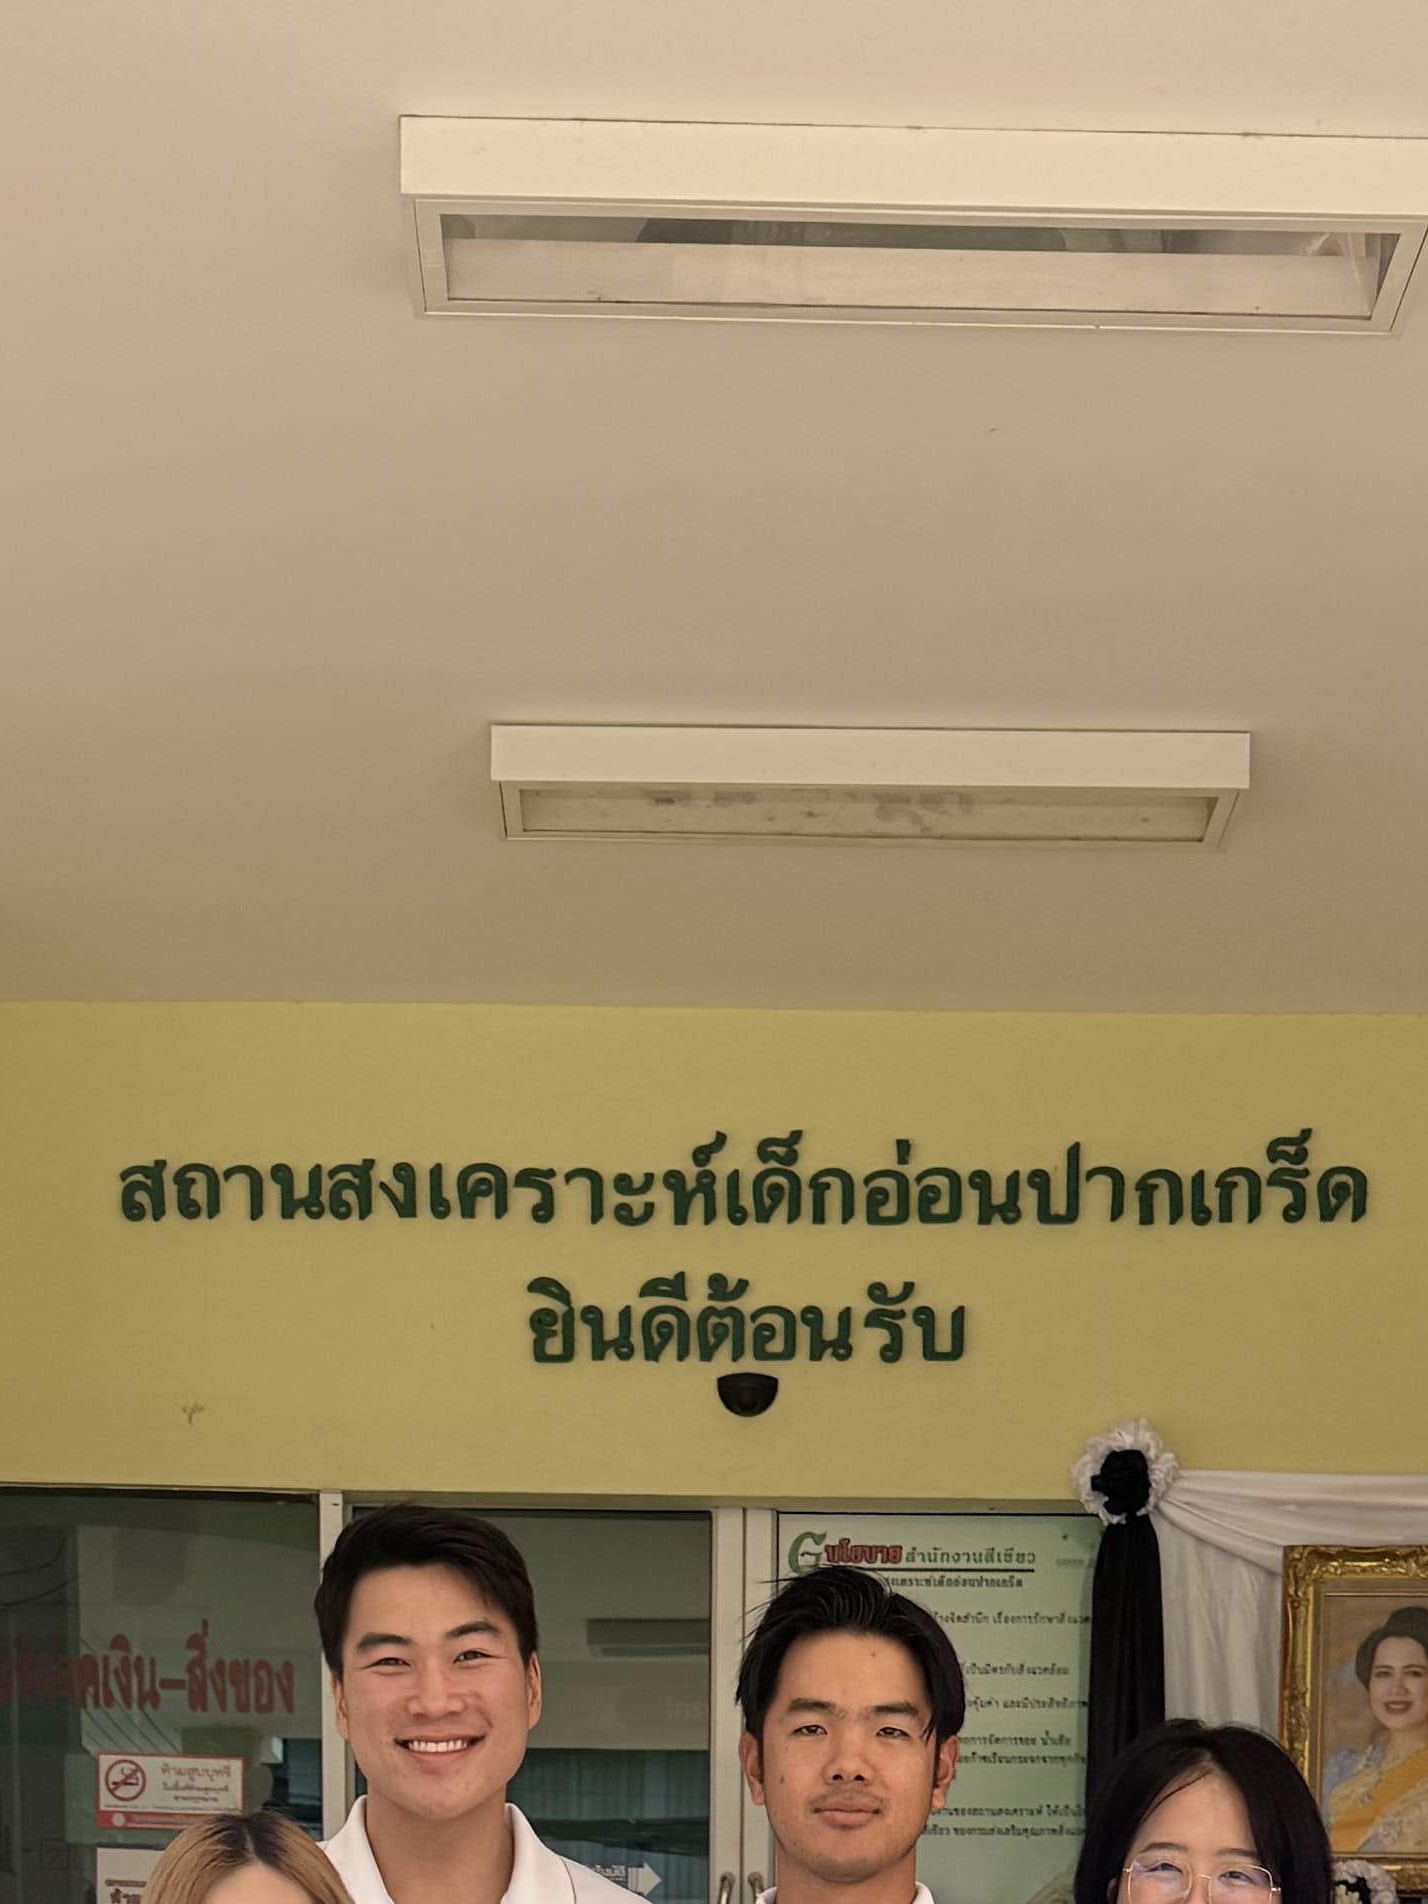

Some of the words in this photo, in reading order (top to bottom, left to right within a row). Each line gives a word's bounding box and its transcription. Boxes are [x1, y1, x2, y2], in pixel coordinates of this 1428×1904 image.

[118, 1131, 1370, 1227] สถานสงเคราะห์เด็กอ่อนปากเกร็ด
[527, 1271, 968, 1365] ยินดีต้อนรับ
